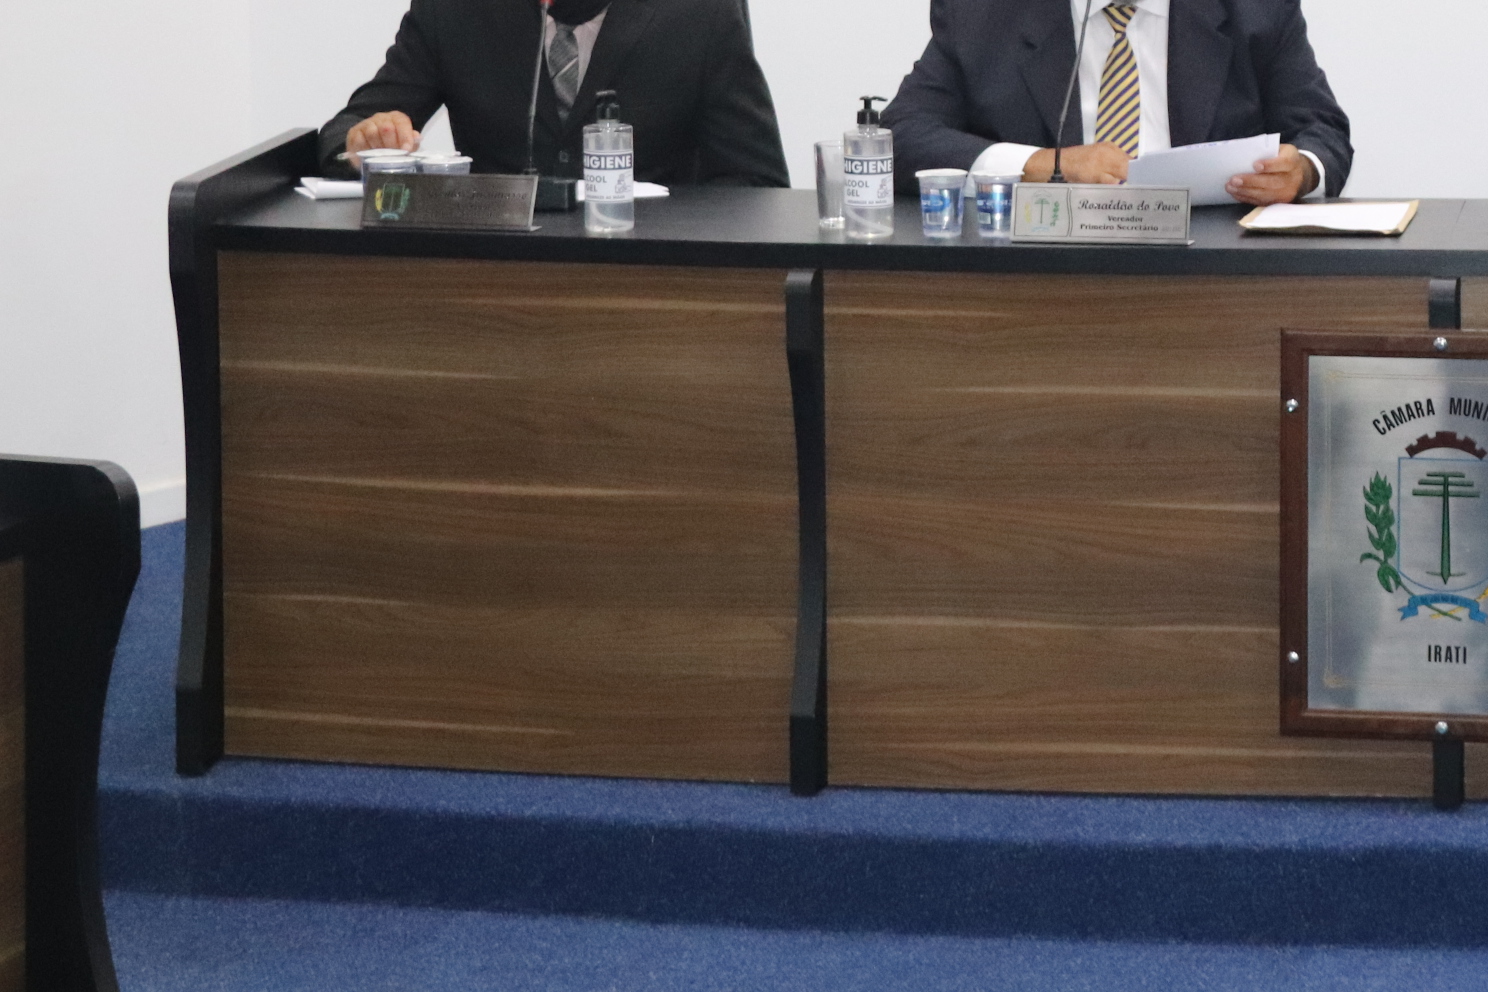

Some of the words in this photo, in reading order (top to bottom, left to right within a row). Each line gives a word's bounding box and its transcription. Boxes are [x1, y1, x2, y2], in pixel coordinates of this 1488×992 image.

[1136, 199, 1151, 212] do
[1153, 200, 1181, 212] Povo
[1107, 214, 1144, 223] Vereador
[1079, 223, 1115, 231] Primeiro
[1116, 223, 1159, 232] Secretário
[1372, 397, 1436, 436] CÂMARA
[1427, 644, 1467, 664] IRATI
